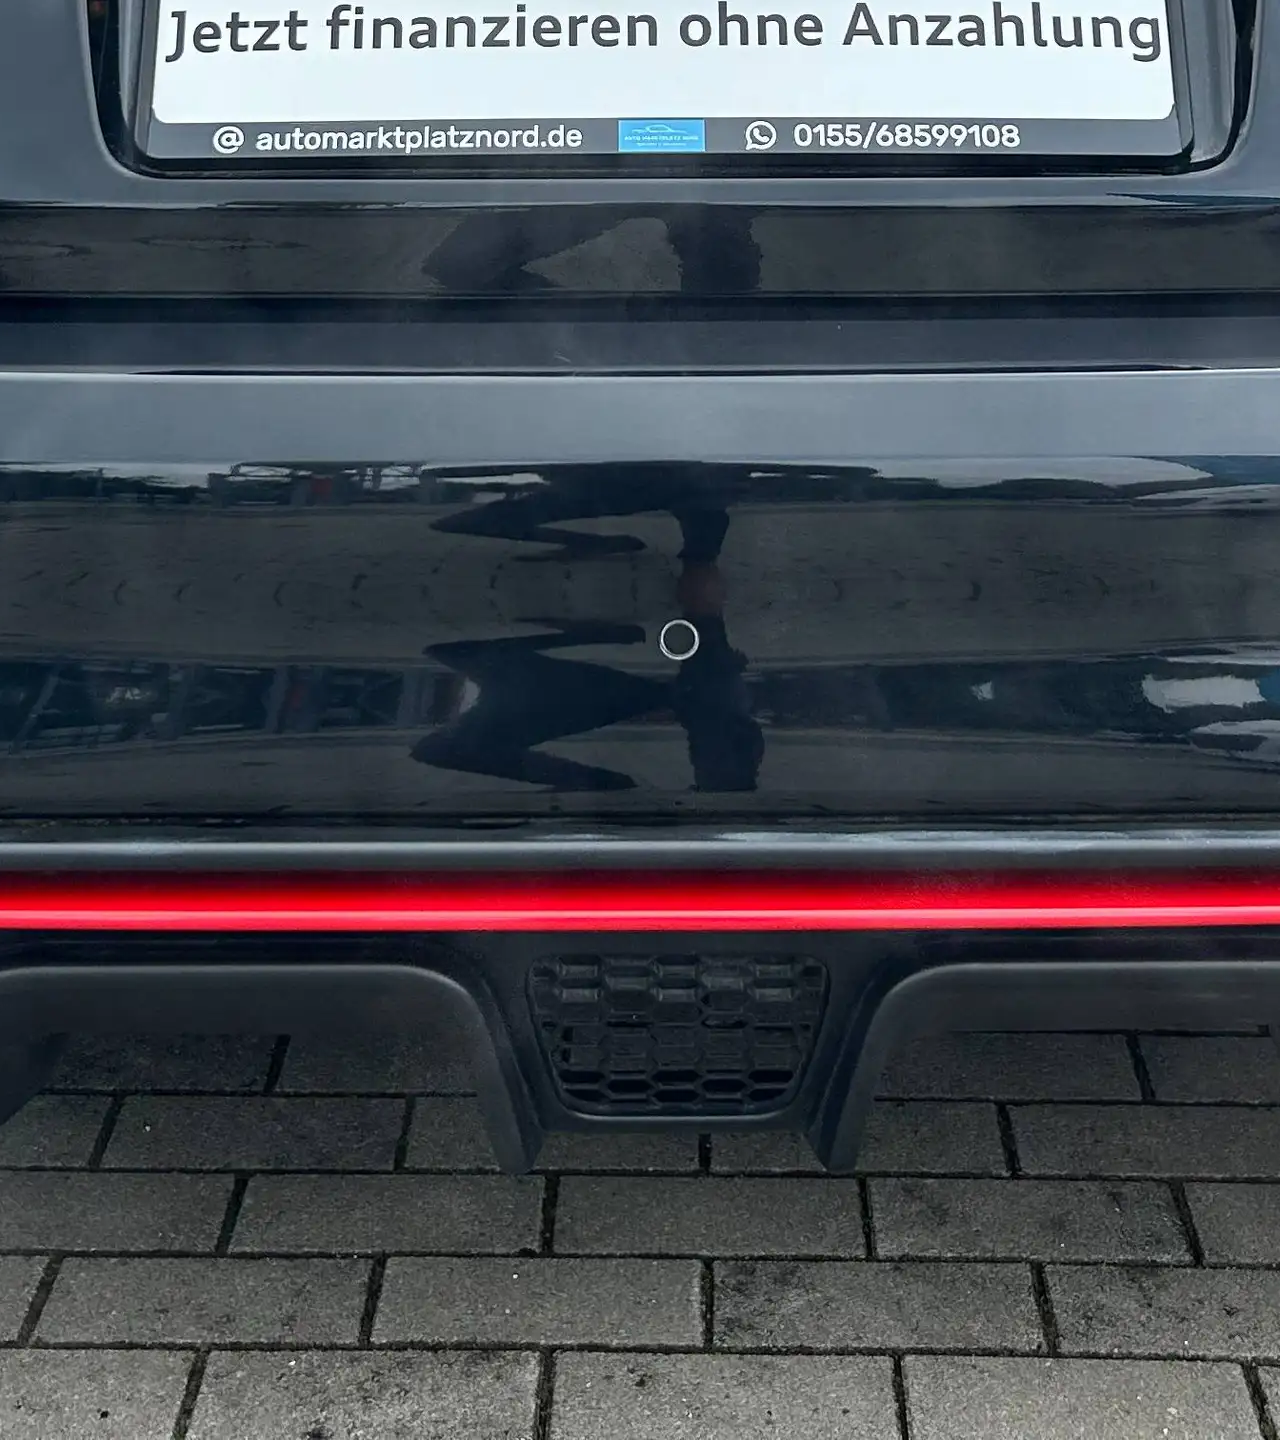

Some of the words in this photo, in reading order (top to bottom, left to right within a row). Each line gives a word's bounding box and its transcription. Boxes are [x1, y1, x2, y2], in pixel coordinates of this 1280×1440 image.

[165, 9, 309, 63] Jetzt
[326, 3, 659, 49] finanzieren
[678, 0, 824, 48] ohne
[842, 1, 1162, 63] Anzahlung
[254, 123, 584, 155] automarktplatznord.de
[792, 122, 1021, 150] 0155/68599108
